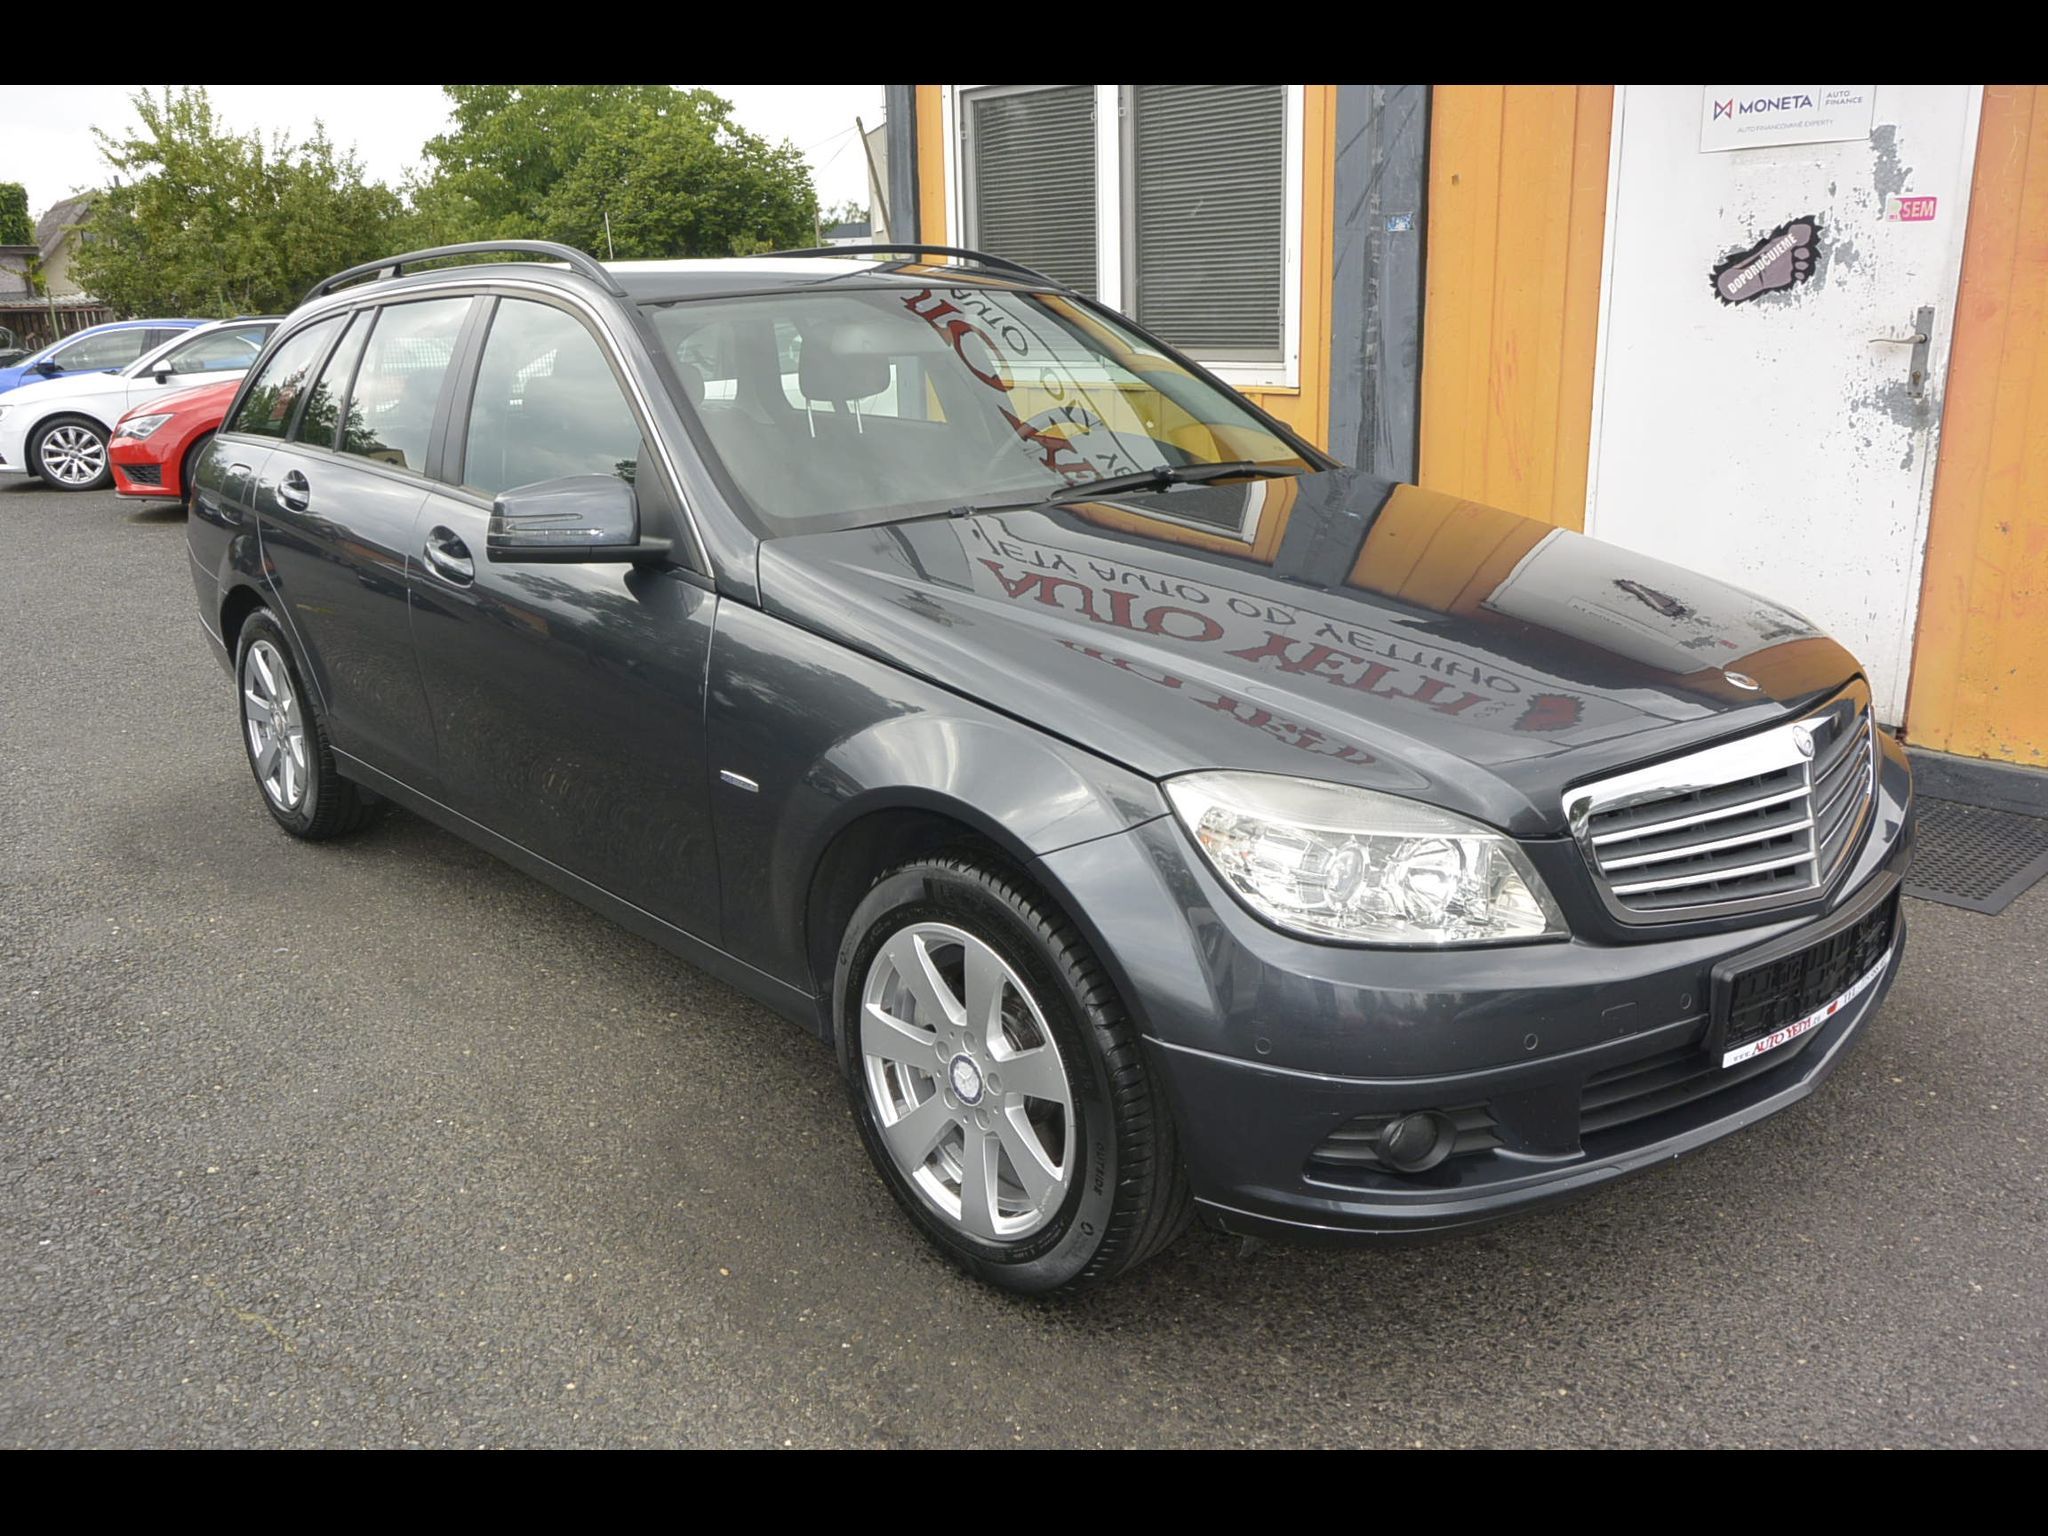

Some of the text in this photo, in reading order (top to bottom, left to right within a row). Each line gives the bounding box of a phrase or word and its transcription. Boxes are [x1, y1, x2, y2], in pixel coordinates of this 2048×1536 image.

[1825, 96, 1863, 106] FINANCE
[1826, 89, 1850, 99] AUTO
[1738, 95, 1813, 115] MONETA
[1901, 200, 1935, 218] SEM
